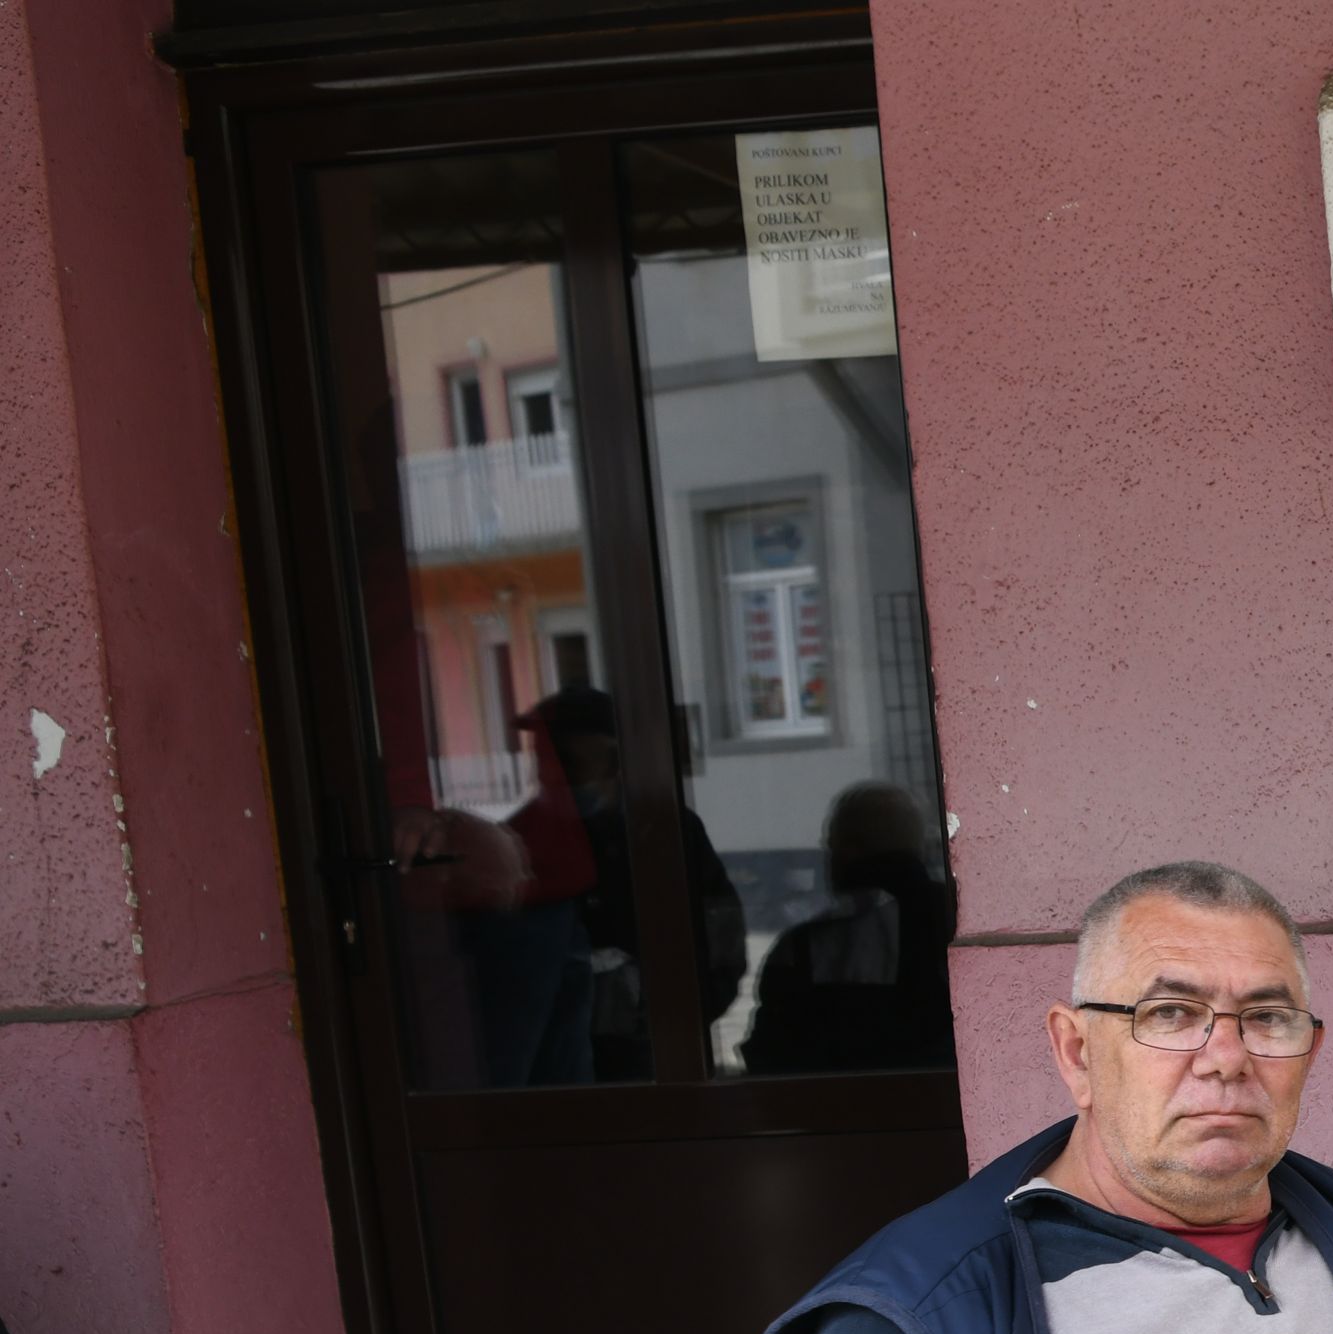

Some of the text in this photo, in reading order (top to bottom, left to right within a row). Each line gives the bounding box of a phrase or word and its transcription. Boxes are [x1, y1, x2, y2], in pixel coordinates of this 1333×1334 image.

[811, 146, 842, 157] KUPCI
[754, 173, 829, 189] PRILIKOM
[755, 192, 832, 208] ULASKA U
[757, 211, 823, 226] OBJEKAT
[758, 227, 860, 244] OBAVEZNO JE
[760, 245, 867, 264] NOSITI MASKU
